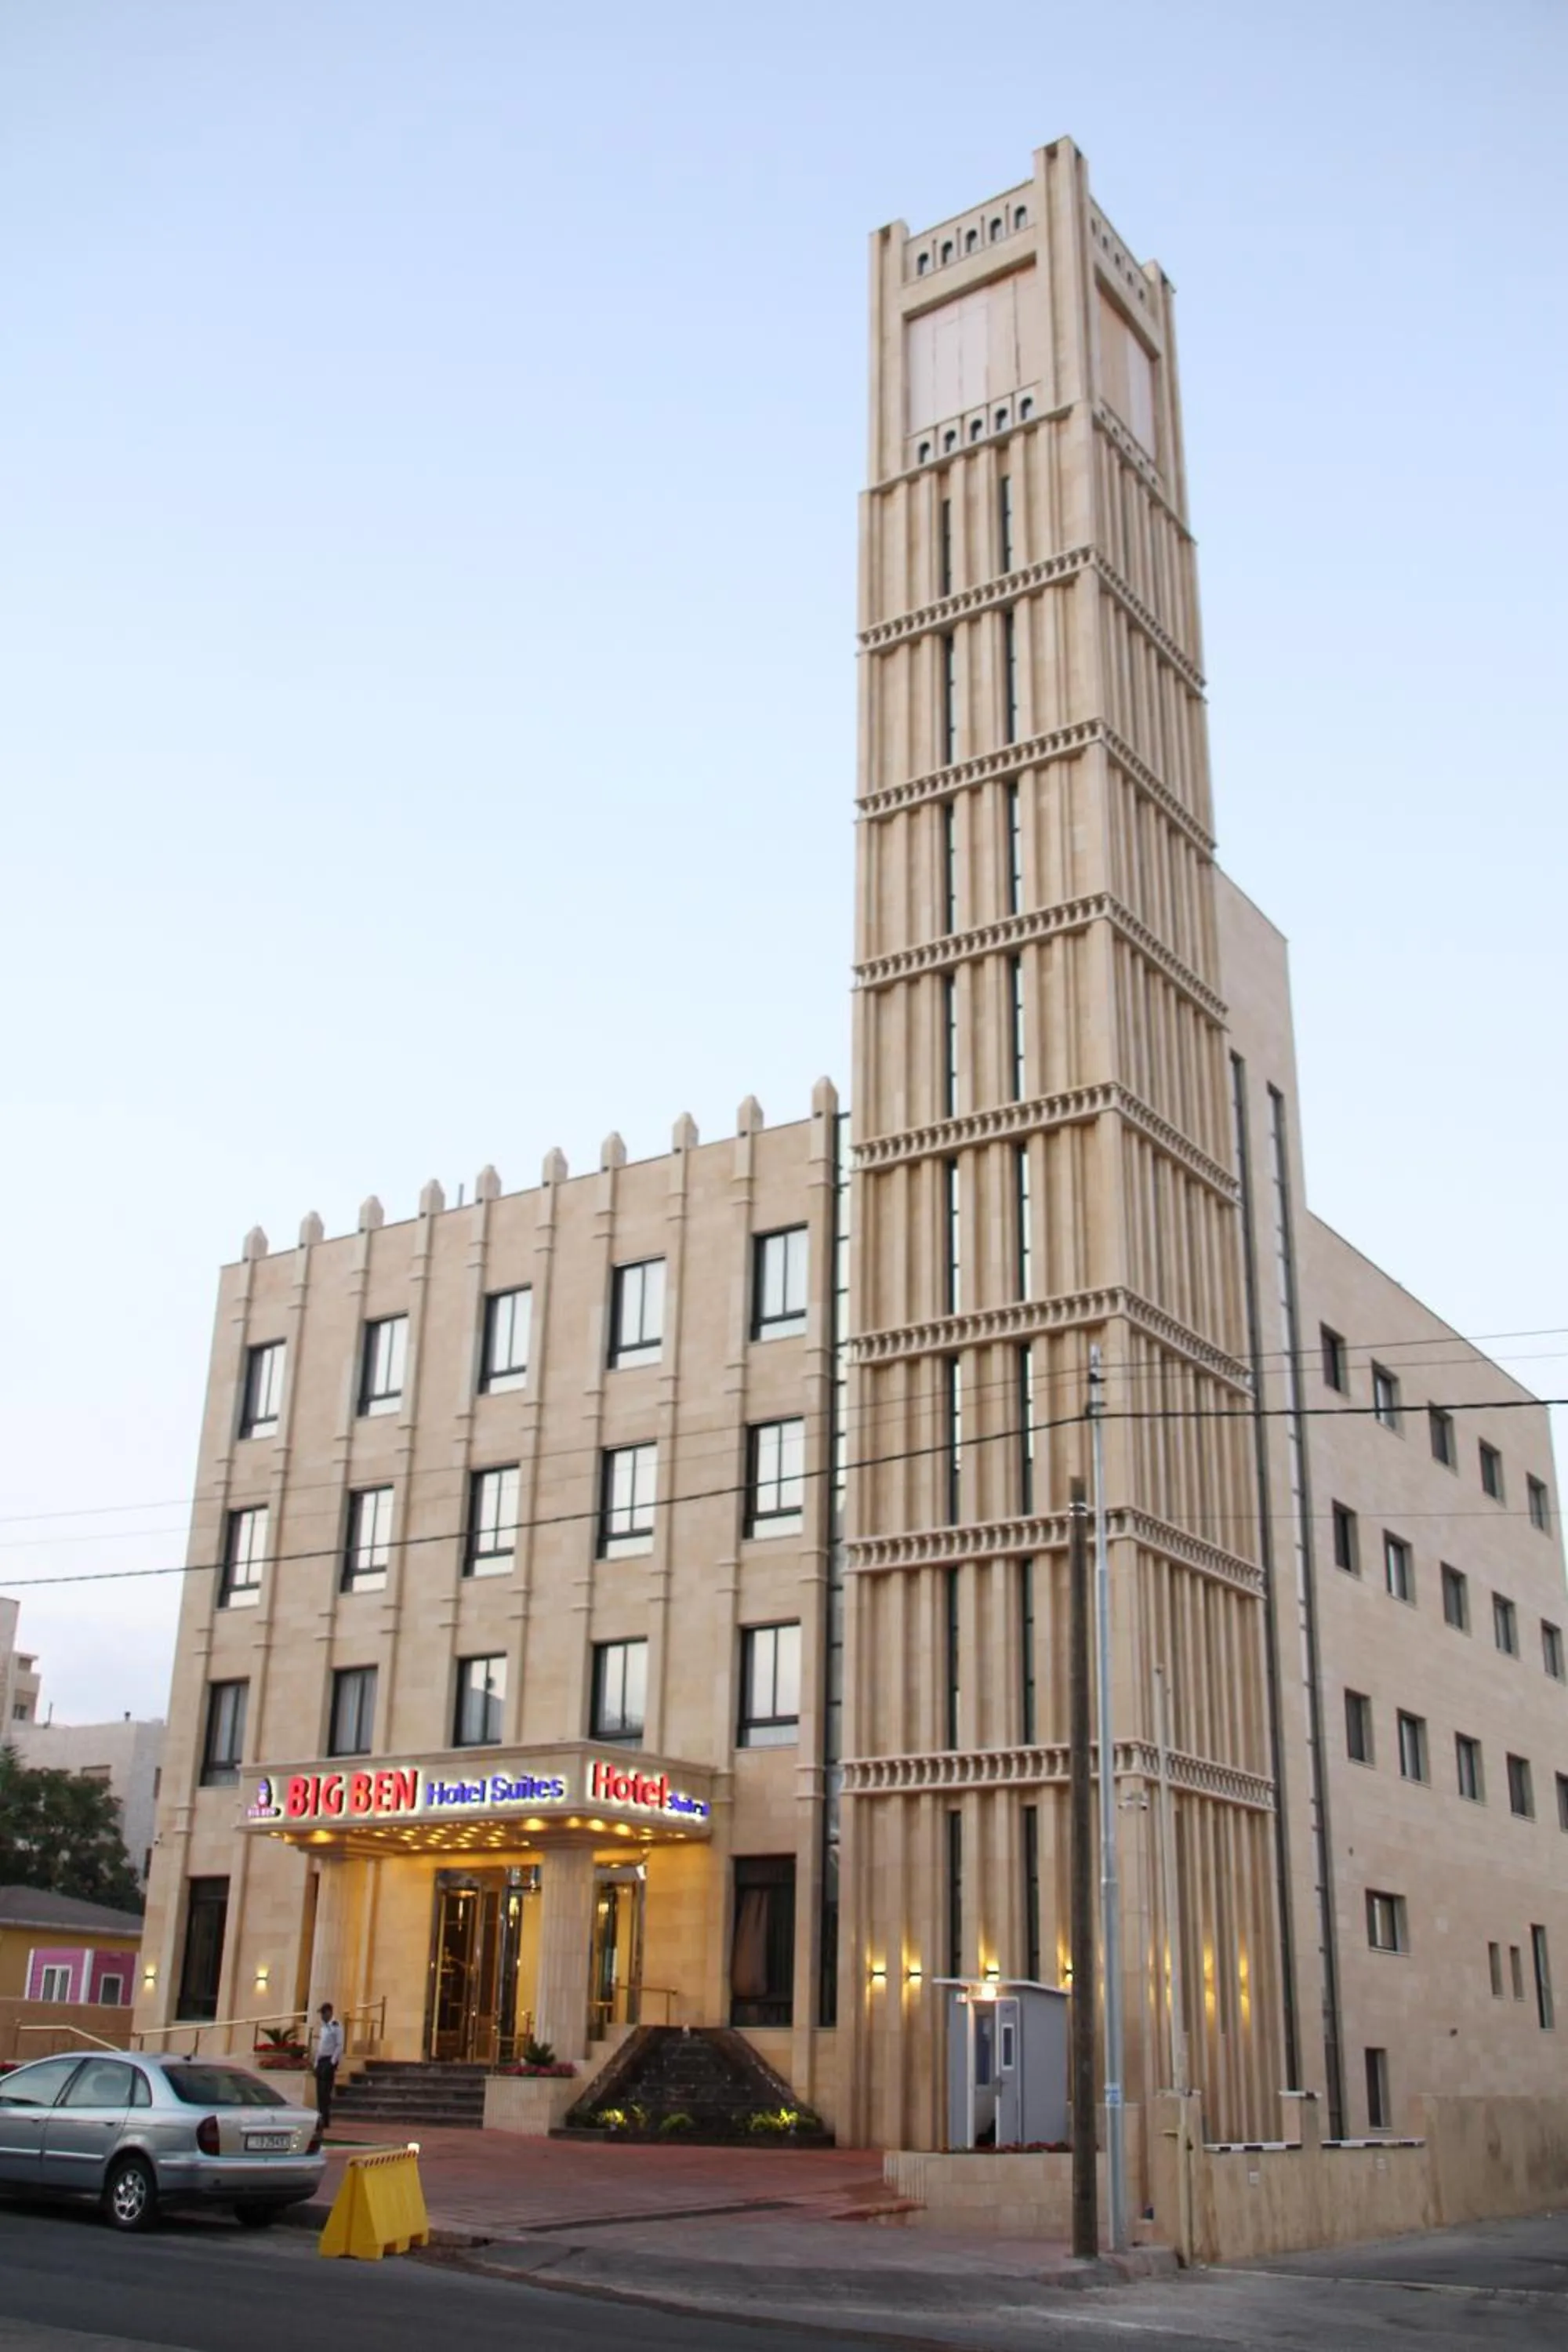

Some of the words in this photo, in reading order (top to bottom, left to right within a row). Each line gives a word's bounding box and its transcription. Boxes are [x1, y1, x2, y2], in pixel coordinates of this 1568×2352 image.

[287, 1775, 344, 1817] BIG
[349, 1769, 418, 1815] BEN
[426, 1779, 486, 1806] Hotel
[490, 1774, 564, 1802] Suites
[593, 1759, 670, 1808] Hotel
